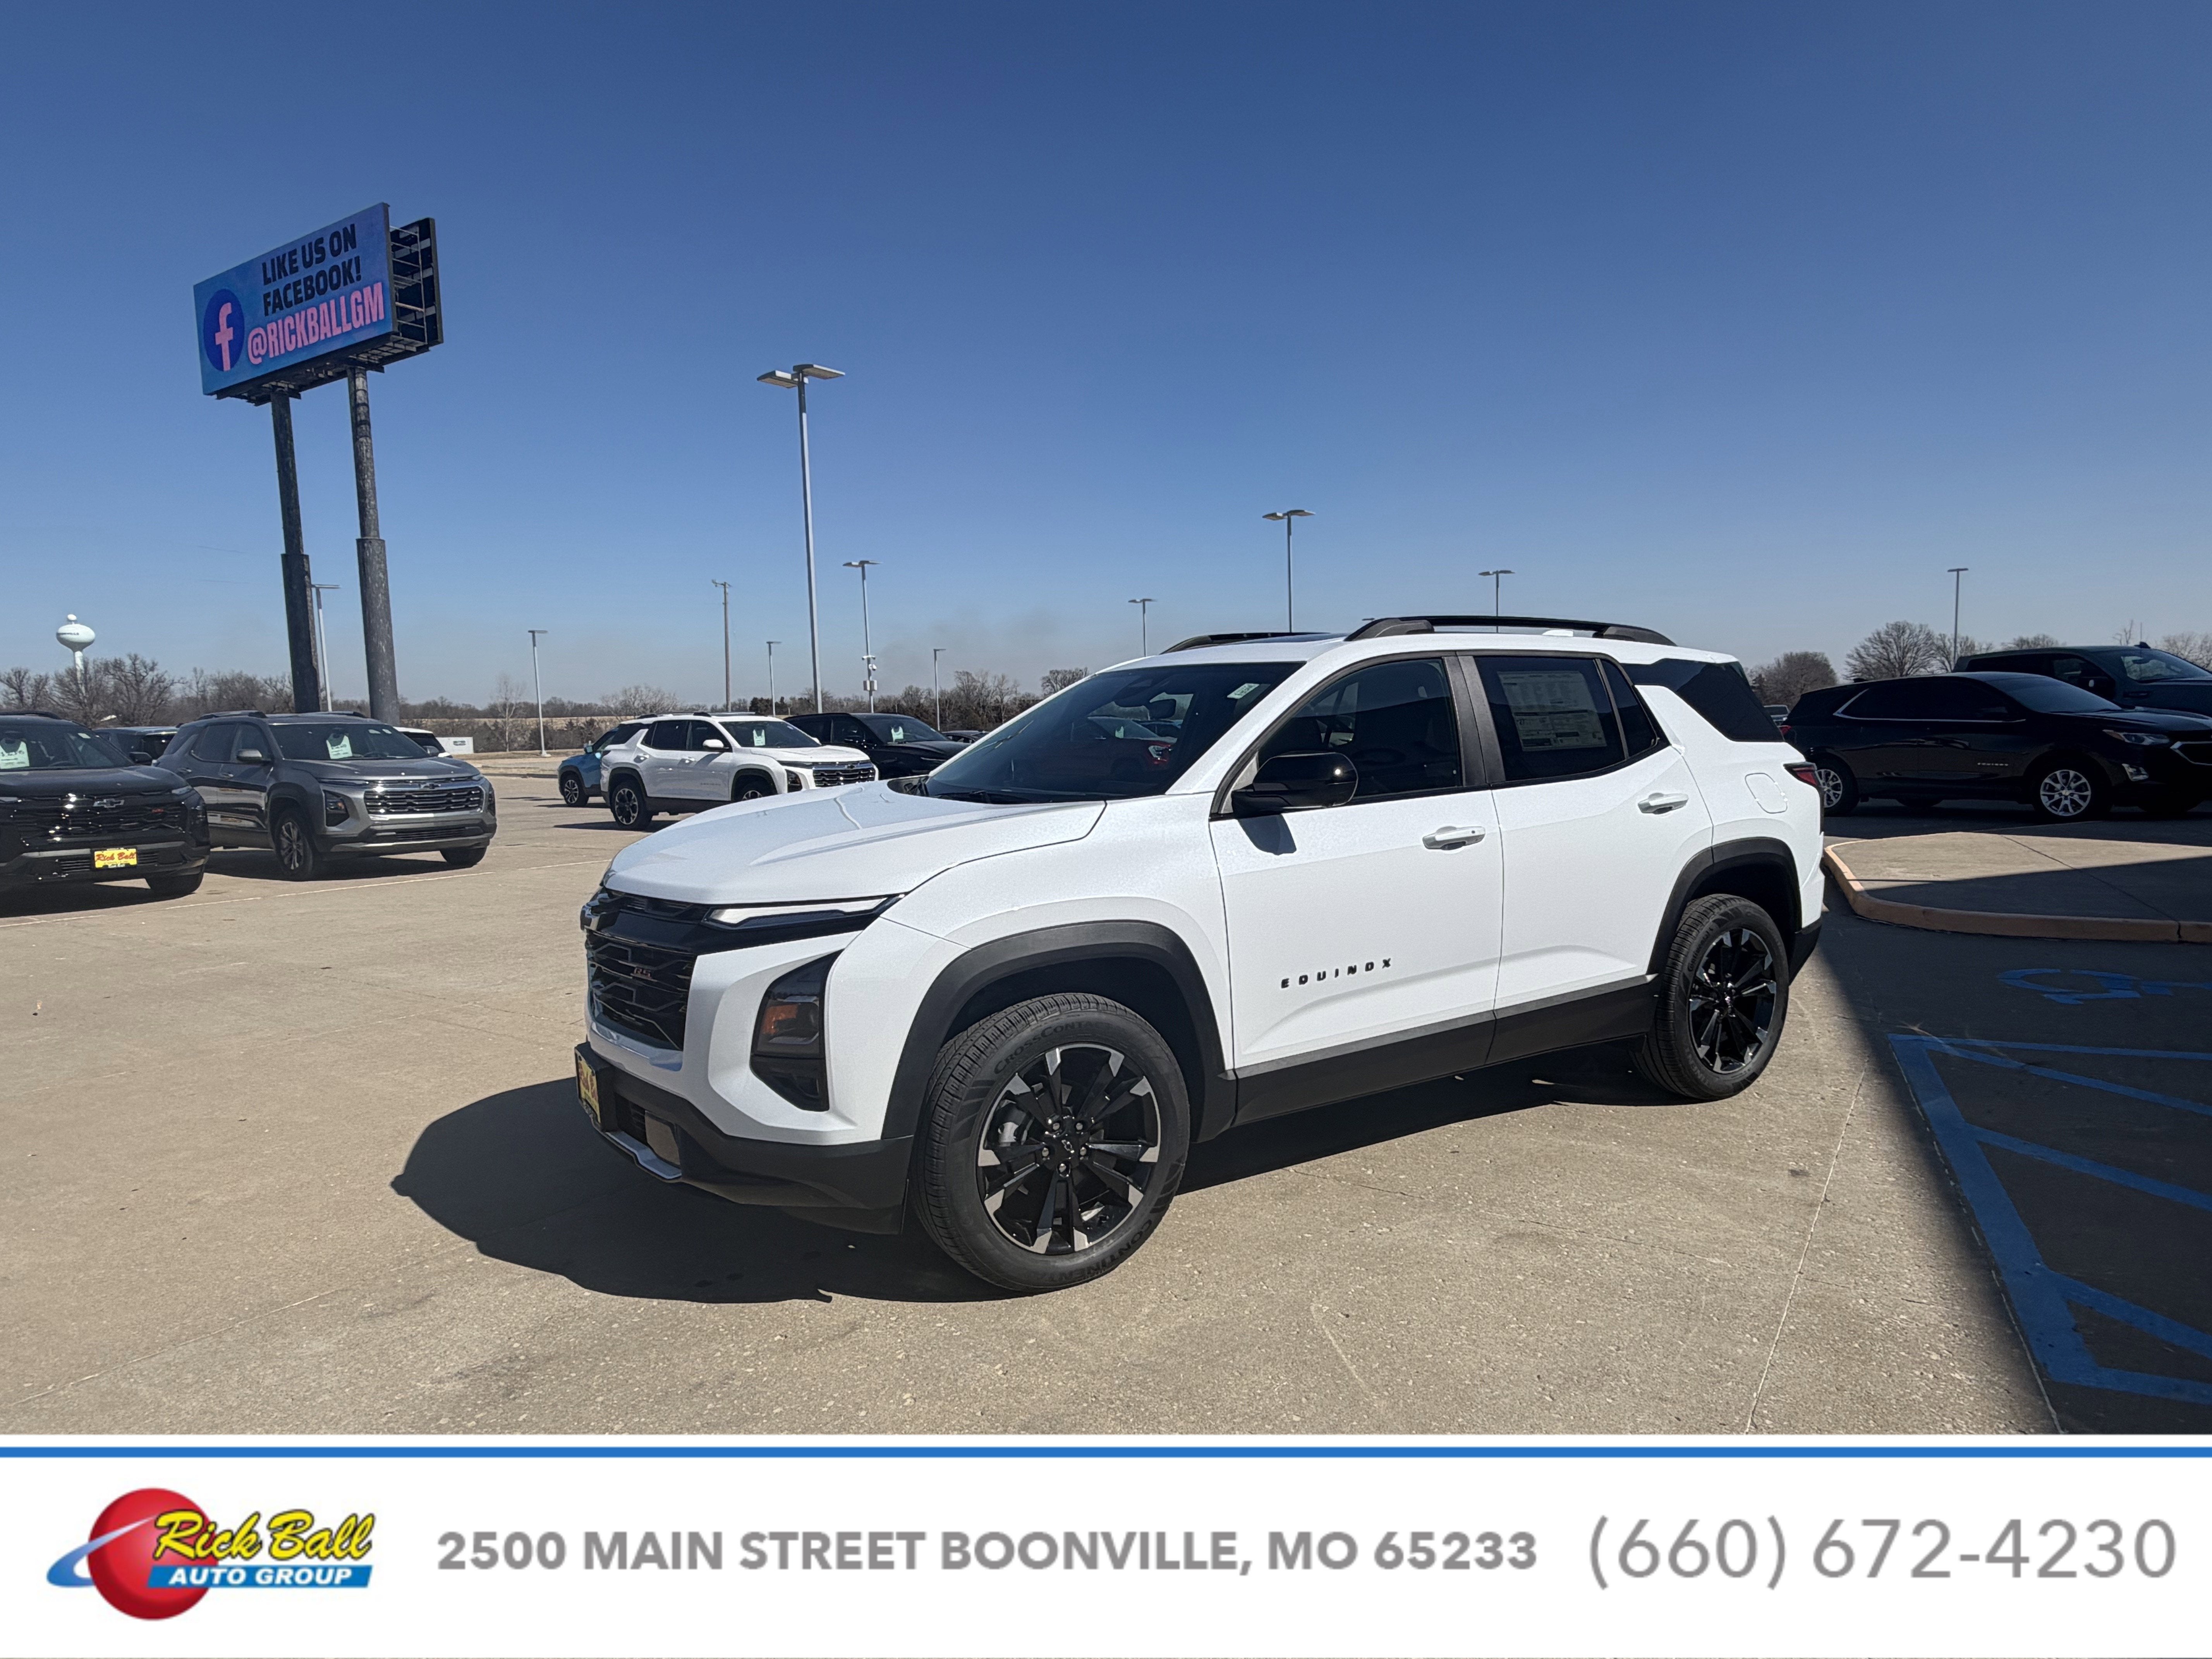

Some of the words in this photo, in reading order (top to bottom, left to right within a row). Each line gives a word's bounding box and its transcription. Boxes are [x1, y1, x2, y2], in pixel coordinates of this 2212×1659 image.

[262, 249, 299, 286] LIKE
[301, 237, 326, 269] US
[329, 223, 357, 257] ON
[263, 256, 362, 317] FACEBOOK!
[215, 302, 233, 371] f
[247, 282, 385, 365] @RICKBALLGM
[1281, 958, 1391, 989] EQUINOX
